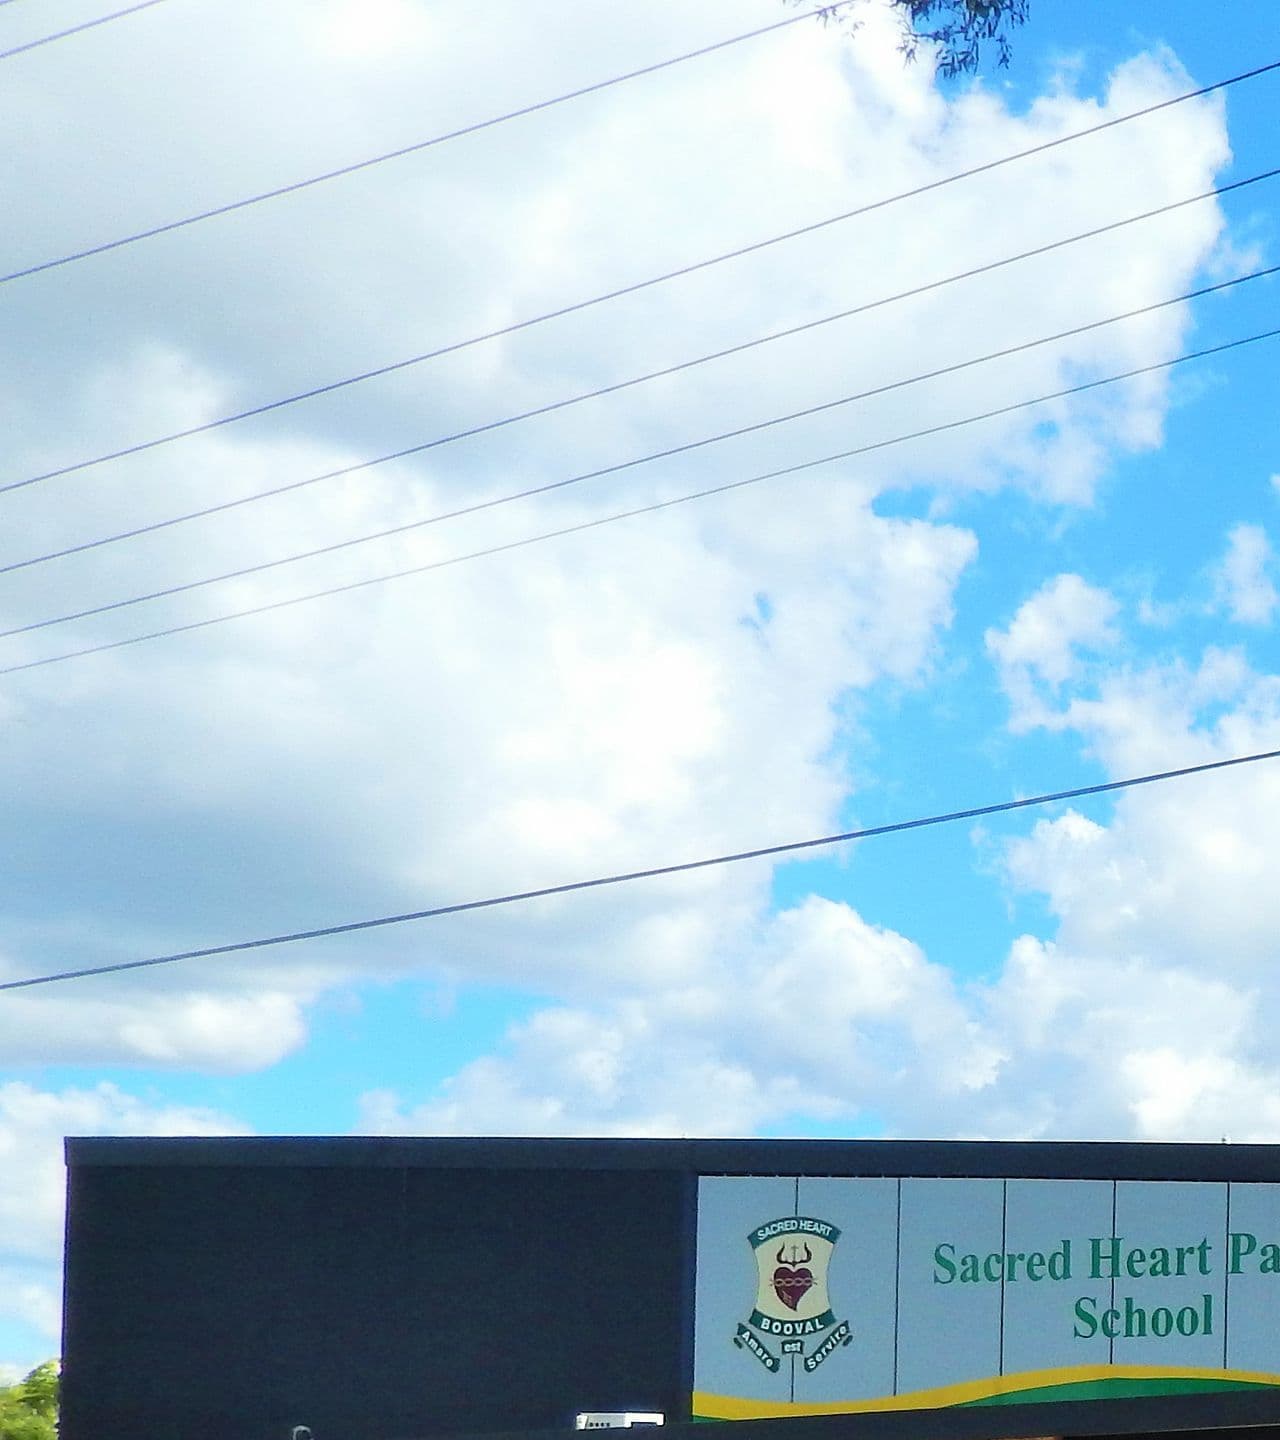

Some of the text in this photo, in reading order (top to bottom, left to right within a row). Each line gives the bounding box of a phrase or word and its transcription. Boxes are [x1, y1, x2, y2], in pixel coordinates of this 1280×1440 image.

[757, 1219, 832, 1240] SACRED HEART
[933, 1240, 1072, 1284] Sacred
[1087, 1234, 1213, 1279] Heart
[760, 1318, 824, 1335] BOOVAL
[1073, 1295, 1213, 1339] School
